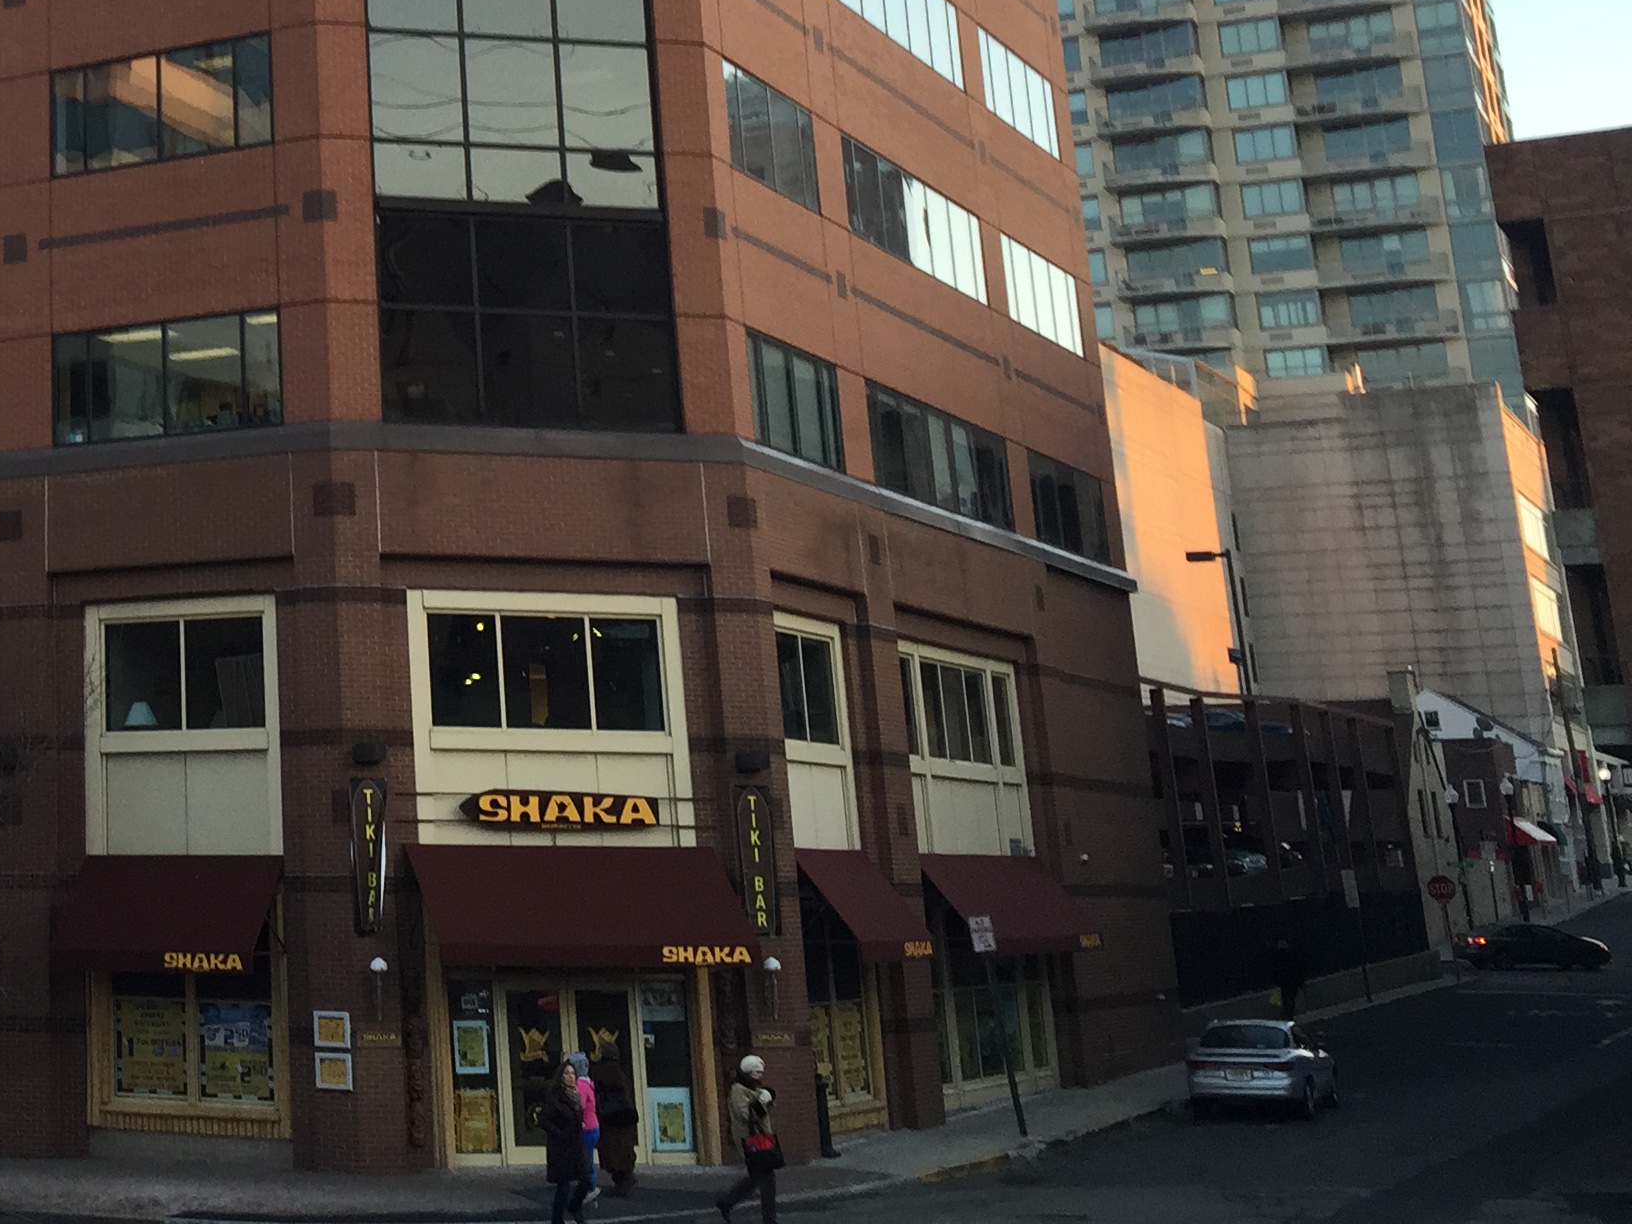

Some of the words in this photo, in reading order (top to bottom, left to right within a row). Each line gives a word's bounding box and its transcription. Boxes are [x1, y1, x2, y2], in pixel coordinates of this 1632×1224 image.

[362, 788, 376, 858] TIKI
[478, 794, 658, 825] SHAKA
[747, 795, 761, 863] TIKI
[754, 876, 767, 928] BAR
[163, 951, 244, 971] SHAKA
[662, 945, 752, 965] SHAKA
